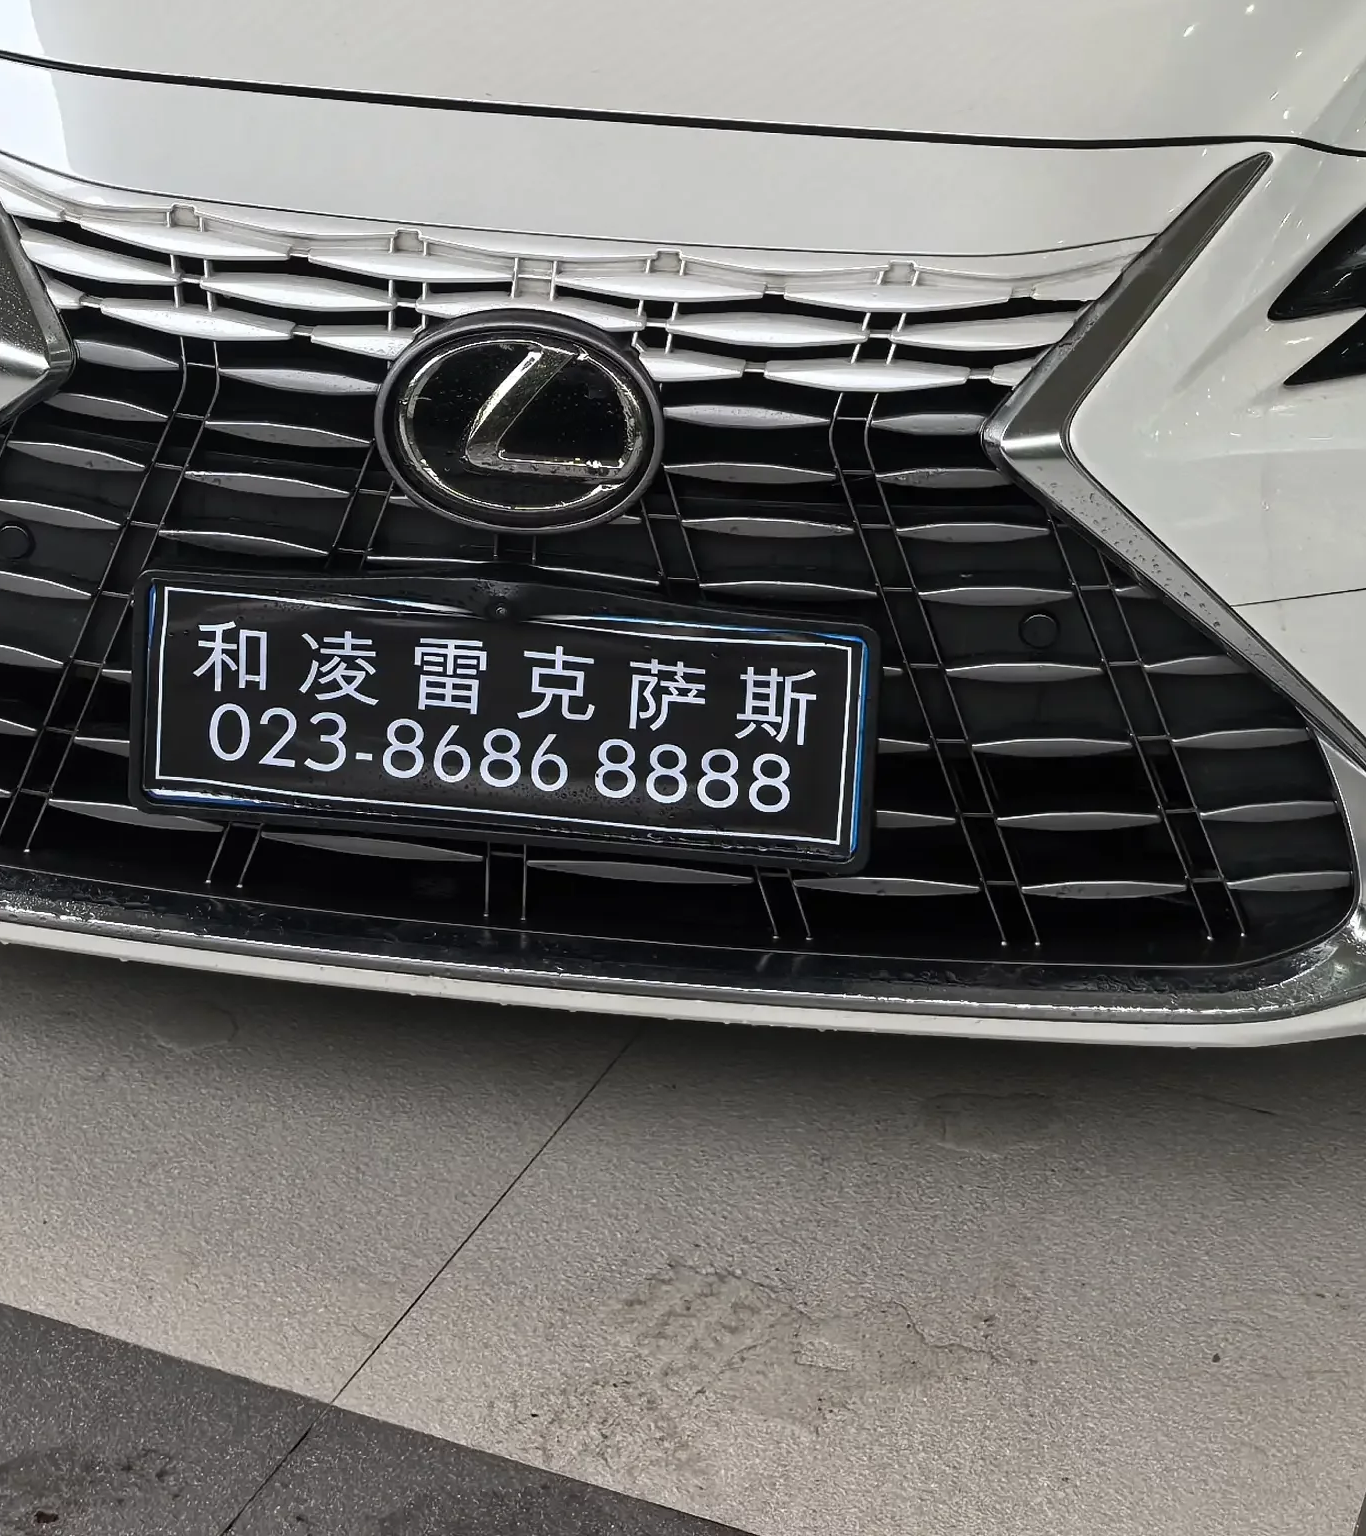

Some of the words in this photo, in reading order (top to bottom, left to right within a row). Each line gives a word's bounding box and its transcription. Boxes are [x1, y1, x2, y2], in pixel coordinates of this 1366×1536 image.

[192, 620, 818, 746] 和凌雷克萨斯
[208, 702, 569, 792] 023-8686
[594, 738, 792, 813] 8888
